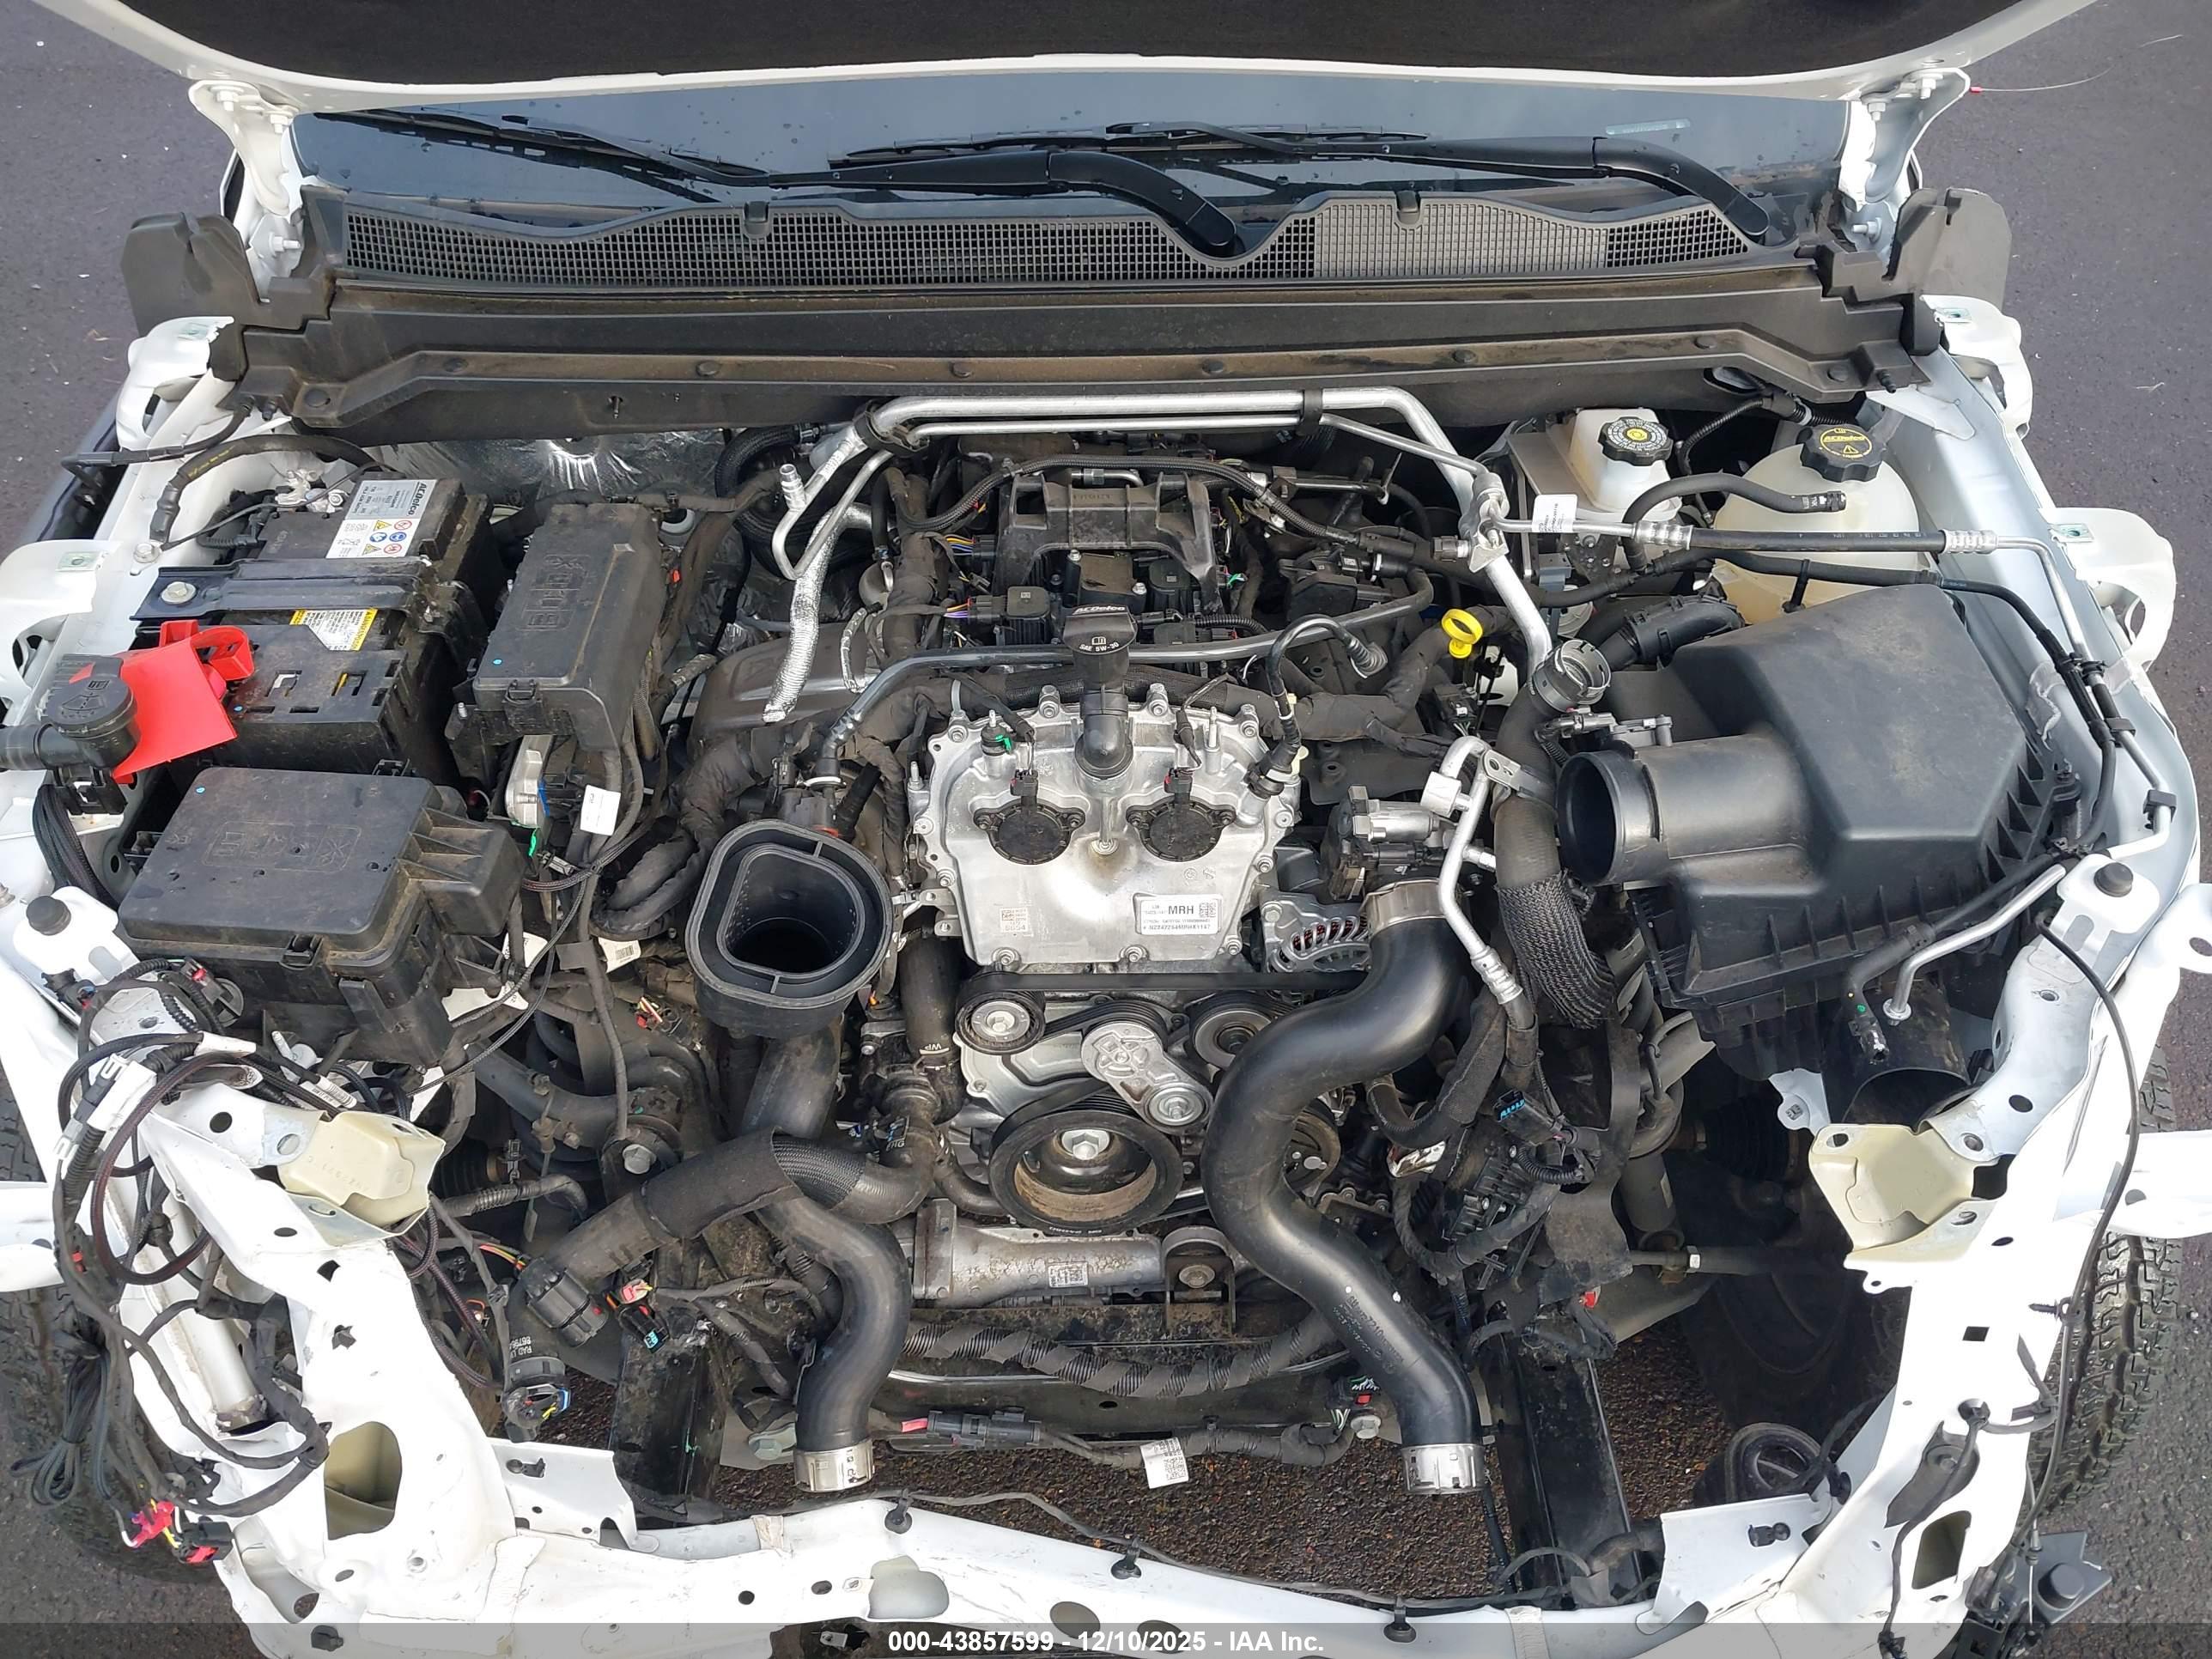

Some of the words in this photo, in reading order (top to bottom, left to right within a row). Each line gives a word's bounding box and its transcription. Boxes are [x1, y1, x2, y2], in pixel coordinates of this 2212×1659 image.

[407, 482, 428, 515] ACDelco
[1073, 605, 1126, 614] ACDelco
[1095, 641, 1120, 652] 5W-30
[1168, 905, 1194, 915] MRH
[518, 1345, 532, 1356] RAD
